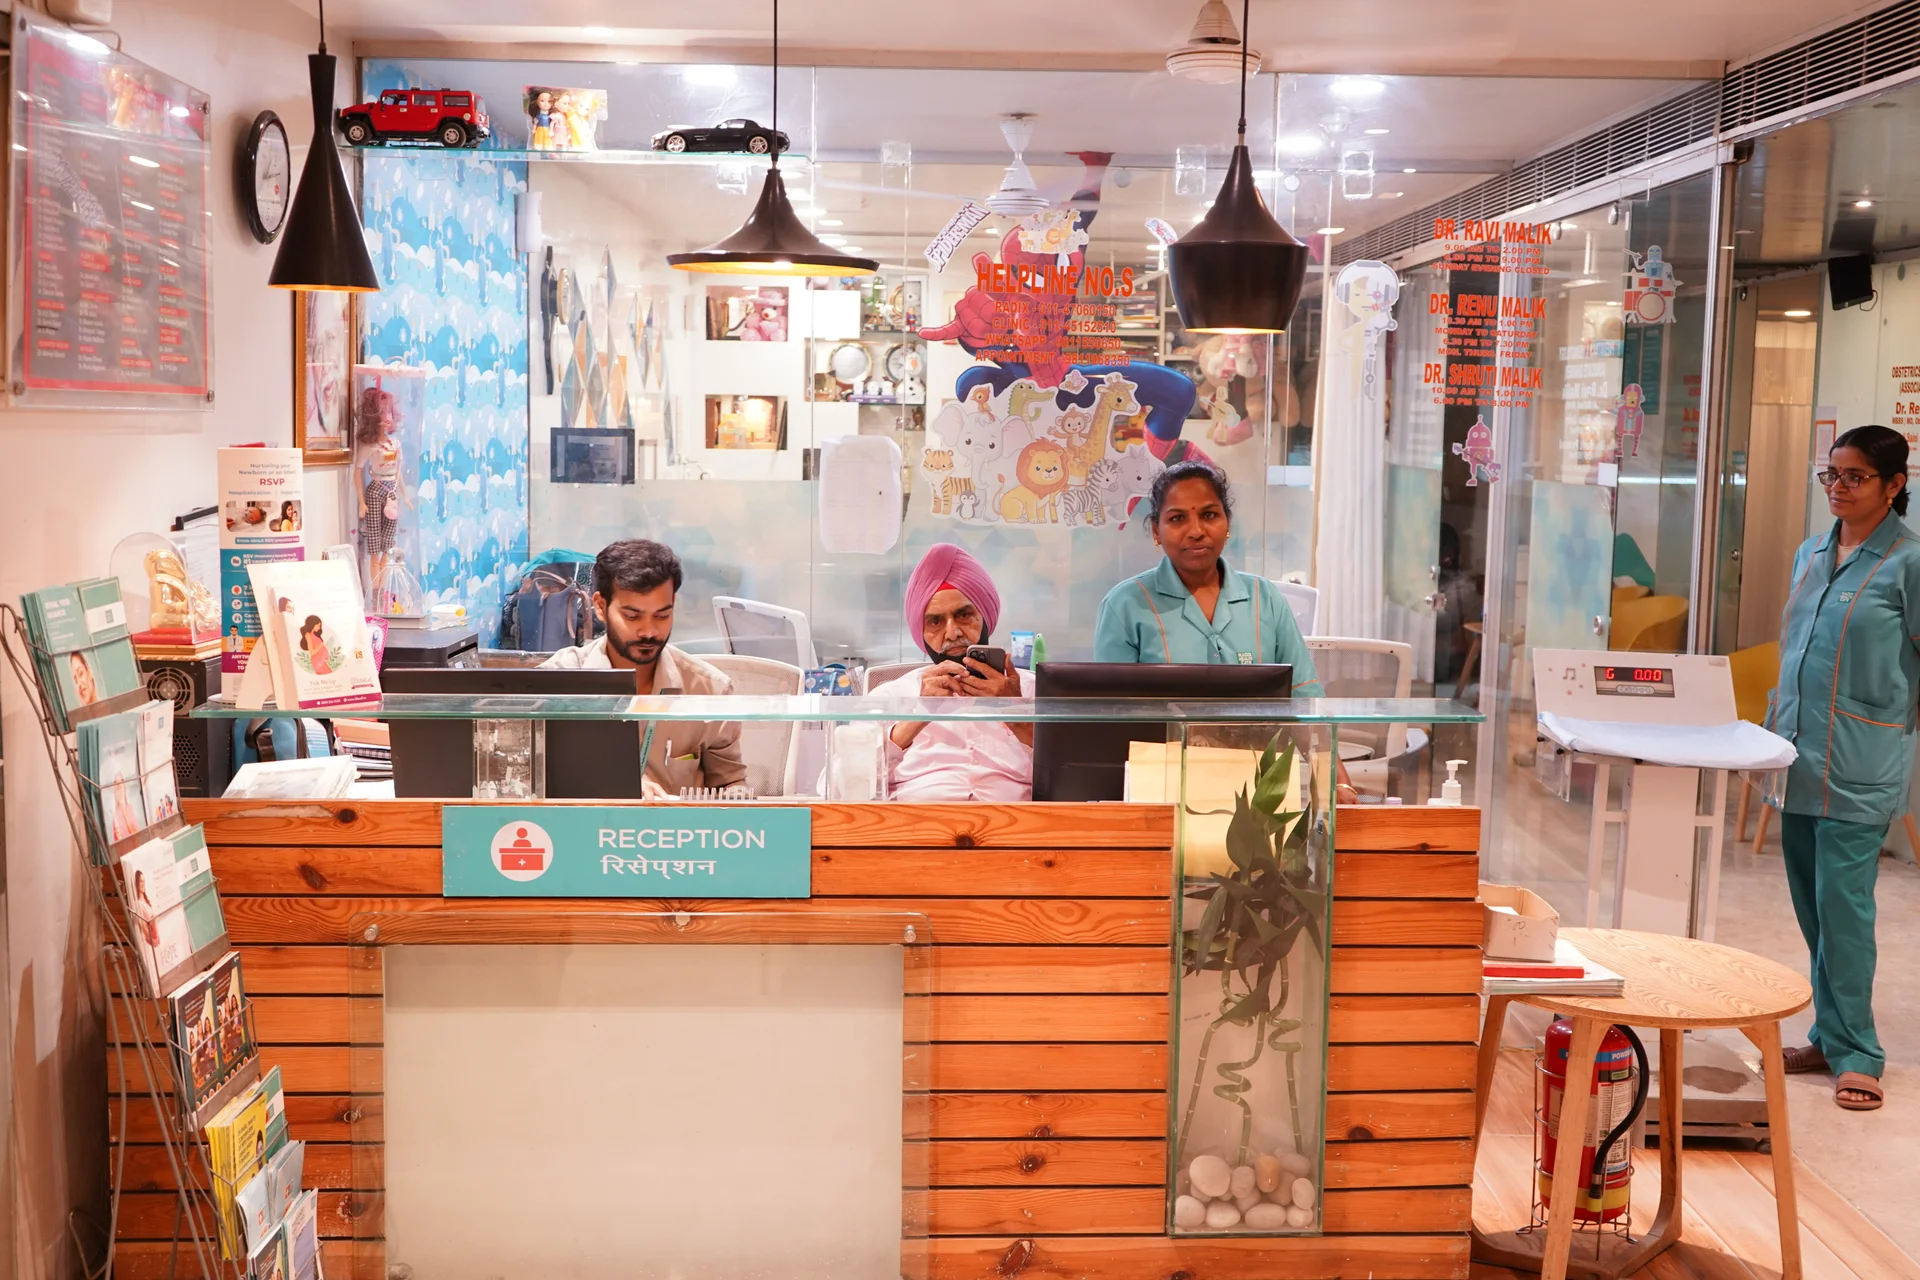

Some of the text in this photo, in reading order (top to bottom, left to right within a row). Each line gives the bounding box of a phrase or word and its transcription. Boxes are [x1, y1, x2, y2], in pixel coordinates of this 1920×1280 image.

[1434, 218, 1552, 245] DR. RAVI MALIK
[1485, 255, 1499, 263] TO
[1502, 256, 1523, 264] 9.00
[1432, 262, 1550, 275] SUNDAY EVENING CLOSED
[977, 263, 1134, 297] HELPLINE NO.S
[995, 302, 1029, 313] RADIX
[1039, 303, 1116, 317] 011-47060150
[1429, 293, 1548, 319] DR. RENU MALIK
[992, 318, 1030, 330] CLINIC
[1039, 319, 1117, 333] 011-45152510
[1467, 318, 1482, 326] AM
[1520, 320, 1533, 328] PM
[1434, 327, 1539, 338] MONDAY TO SATURDAY
[985, 334, 1046, 347] WHATSAPP
[1480, 339, 1493, 347] TO
[1495, 340, 1513, 348] 7.30
[975, 350, 1055, 364] APPOINTMENT
[1438, 348, 1461, 356] MON.
[1500, 350, 1533, 359] FRIDAY
[1424, 363, 1445, 384] DR.
[1449, 363, 1497, 386] SHRUTI
[1501, 366, 1543, 389] MALIK
[1460, 388, 1476, 396] AM
[1896, 402, 1920, 414] Dr. Re
[260, 478, 285, 486] RSVP
[598, 828, 766, 849] RECEPTION
